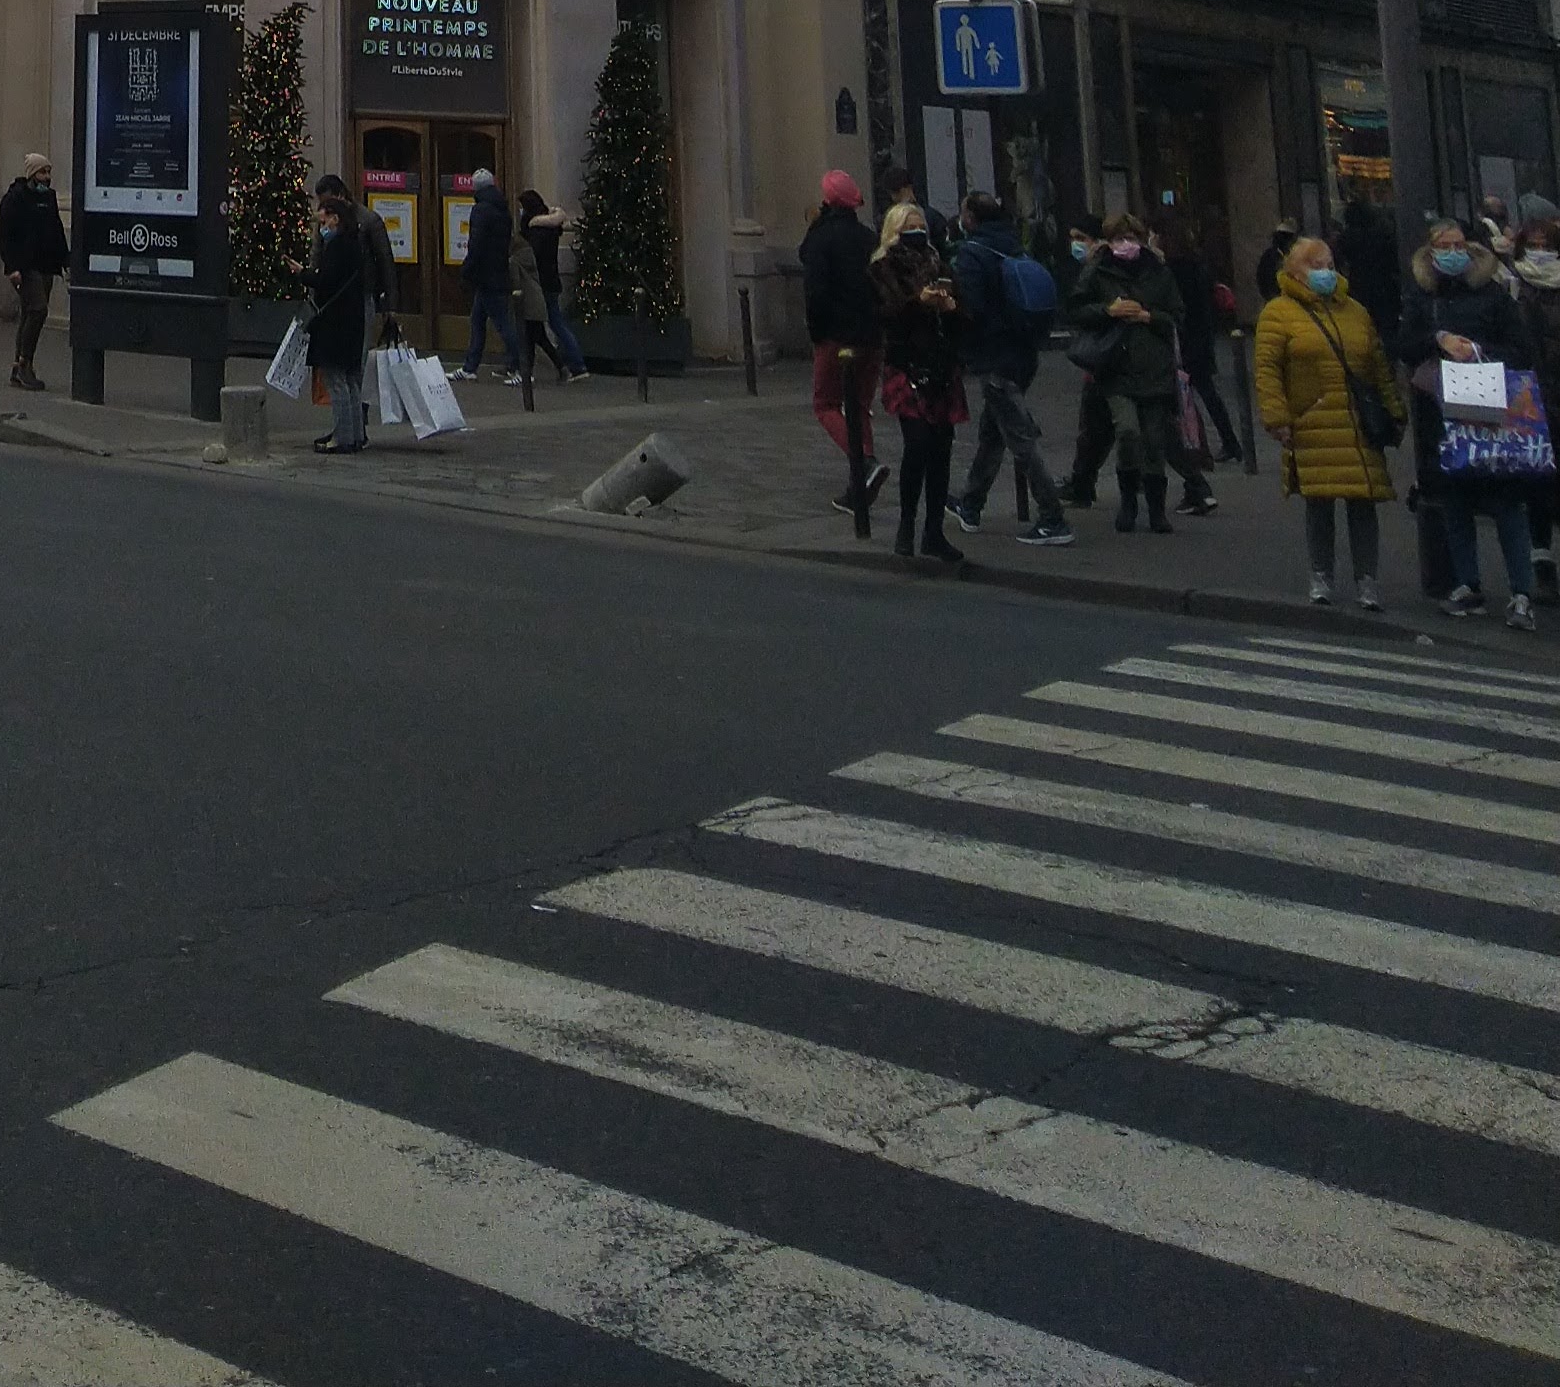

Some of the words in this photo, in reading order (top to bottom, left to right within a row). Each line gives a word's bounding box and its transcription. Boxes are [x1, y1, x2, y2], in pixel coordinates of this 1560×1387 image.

[368, 16, 488, 37] PRINTEMPS
[362, 39, 389, 55] DE
[396, 40, 493, 60] L'HOMME
[366, 171, 401, 183] ENTRÉE
[109, 230, 129, 245] Bell
[150, 232, 178, 247] Ross
